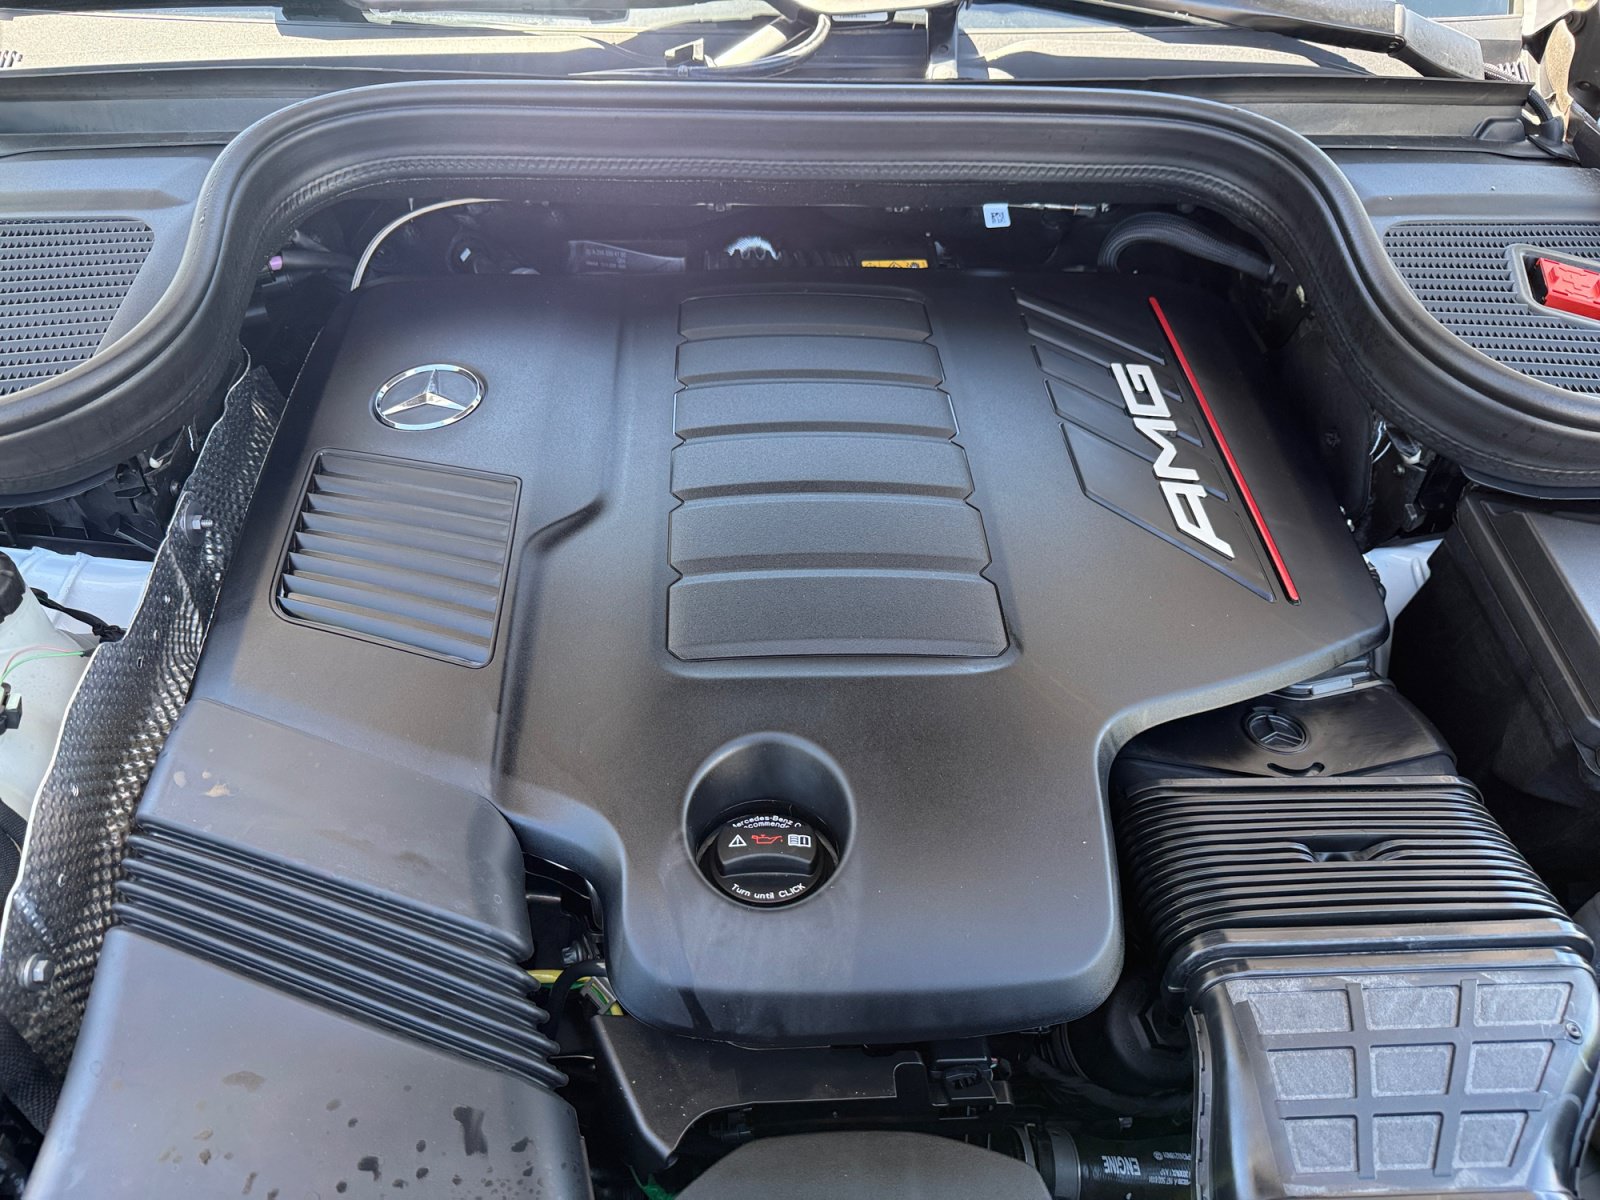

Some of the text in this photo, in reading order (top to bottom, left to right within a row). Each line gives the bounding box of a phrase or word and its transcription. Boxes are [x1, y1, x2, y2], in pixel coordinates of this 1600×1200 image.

[1110, 362, 1236, 559] AMG
[731, 883, 806, 900] Turn until CLICK
[1101, 1155, 1141, 1176] ENGINE
